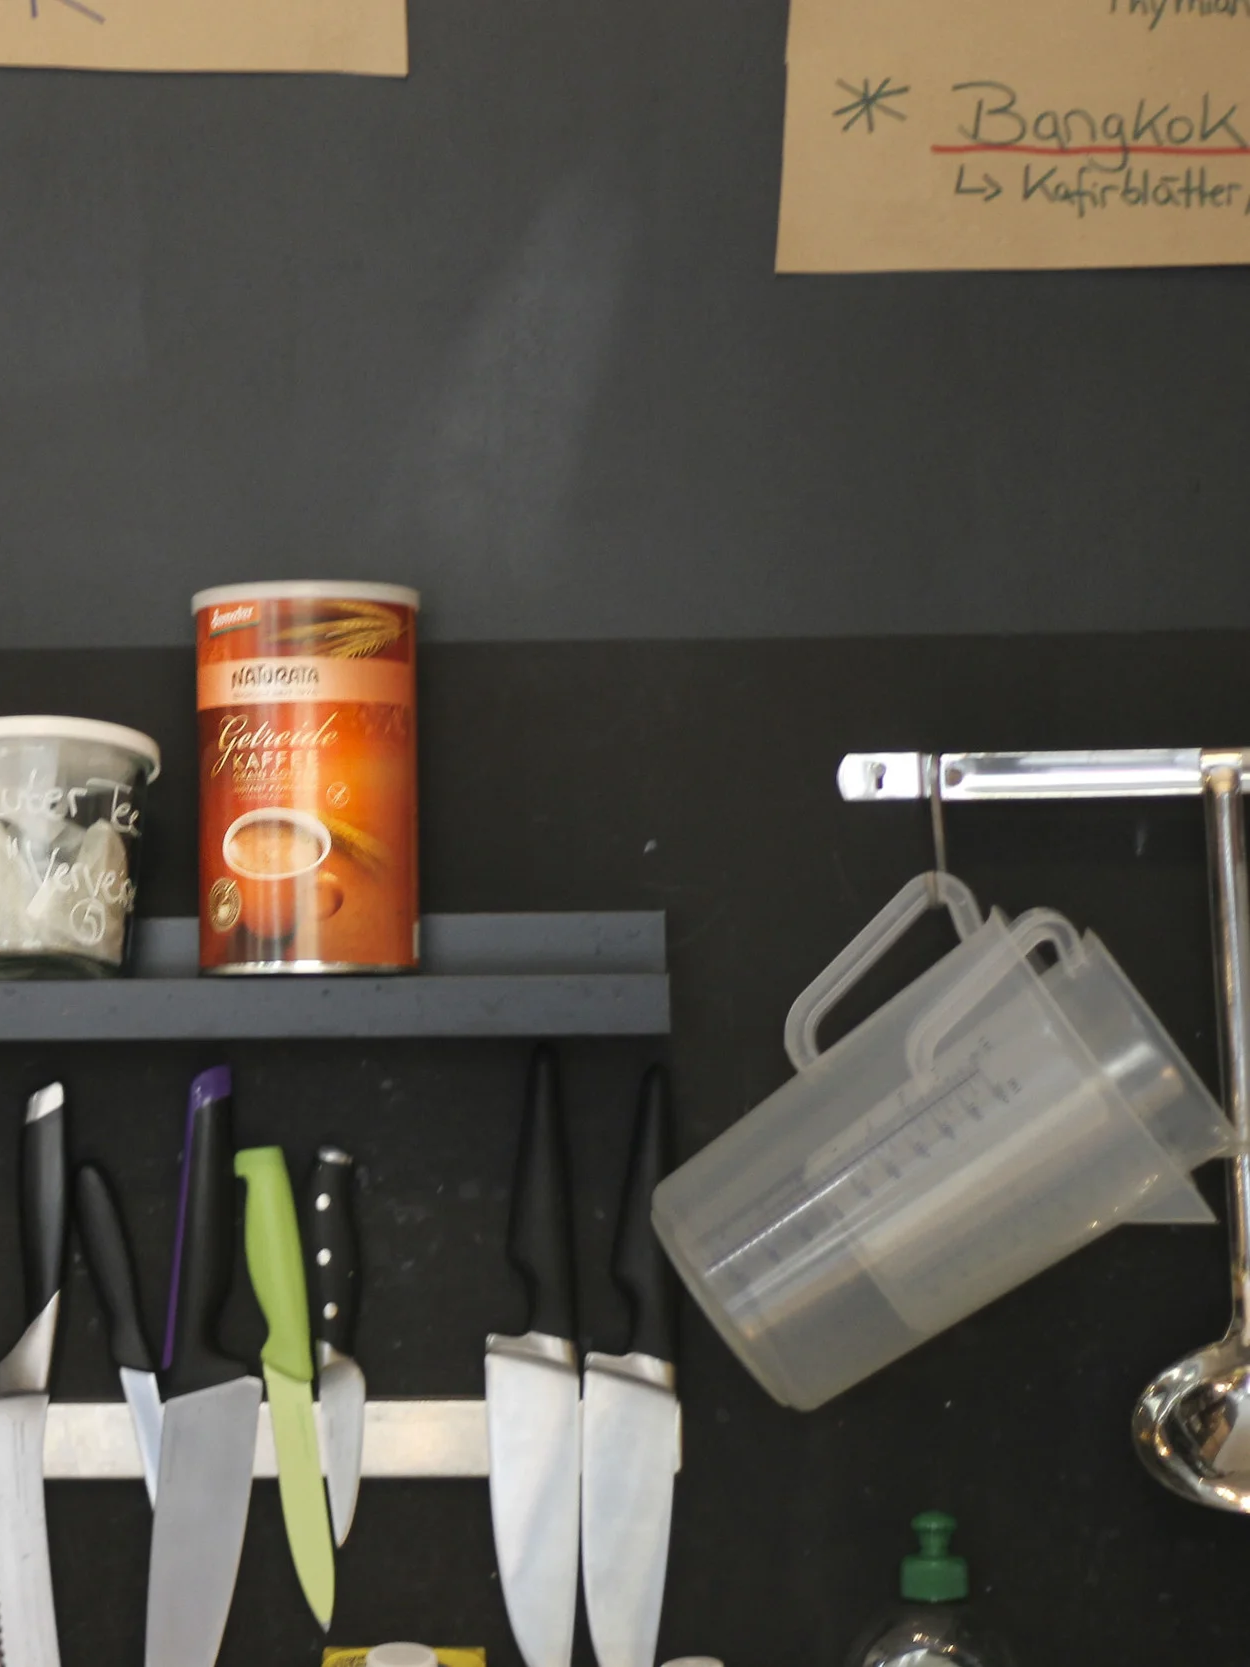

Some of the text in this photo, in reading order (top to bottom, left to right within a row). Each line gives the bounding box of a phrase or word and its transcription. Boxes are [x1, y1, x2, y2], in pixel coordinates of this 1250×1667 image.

[951, 81, 1250, 172] Bangkok
[231, 663, 320, 689] NATURATA
[210, 710, 339, 778] Getreide
[232, 749, 319, 771] KAFFEE
